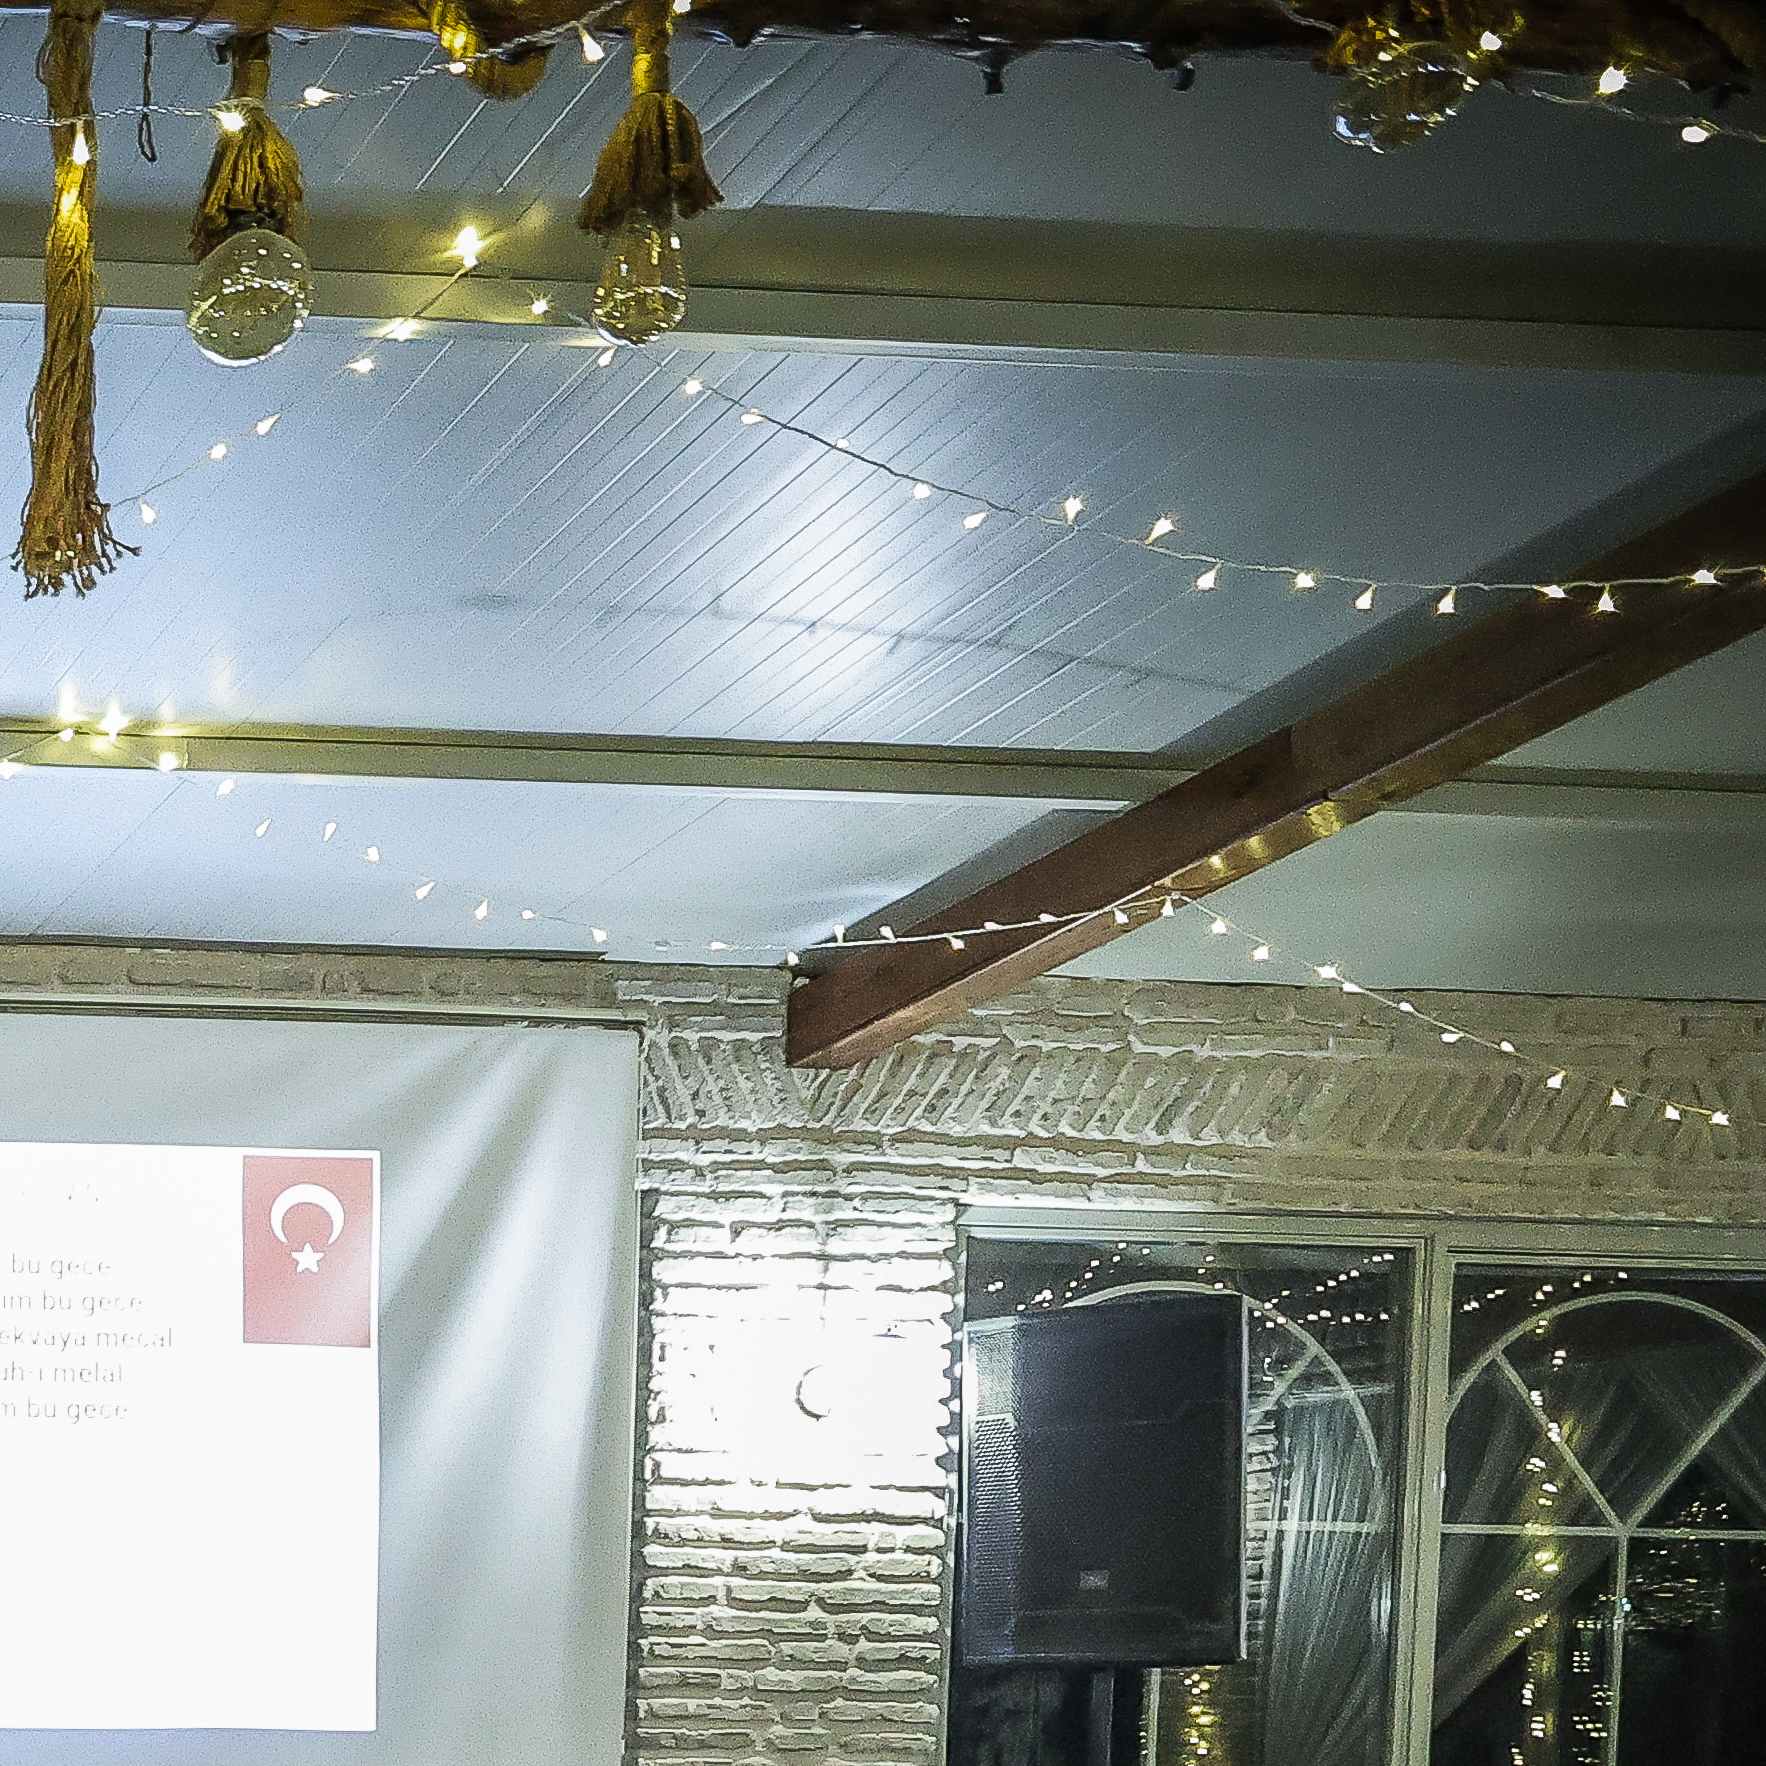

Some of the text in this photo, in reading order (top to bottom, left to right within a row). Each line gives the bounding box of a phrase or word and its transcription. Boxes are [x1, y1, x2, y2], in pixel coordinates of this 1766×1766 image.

[12, 1252, 41, 1274] bu
[51, 1259, 111, 1281] gece
[43, 1290, 72, 1311] bu
[82, 1296, 142, 1317] gece
[27, 1397, 57, 1418] bu
[67, 1403, 128, 1425] gece
